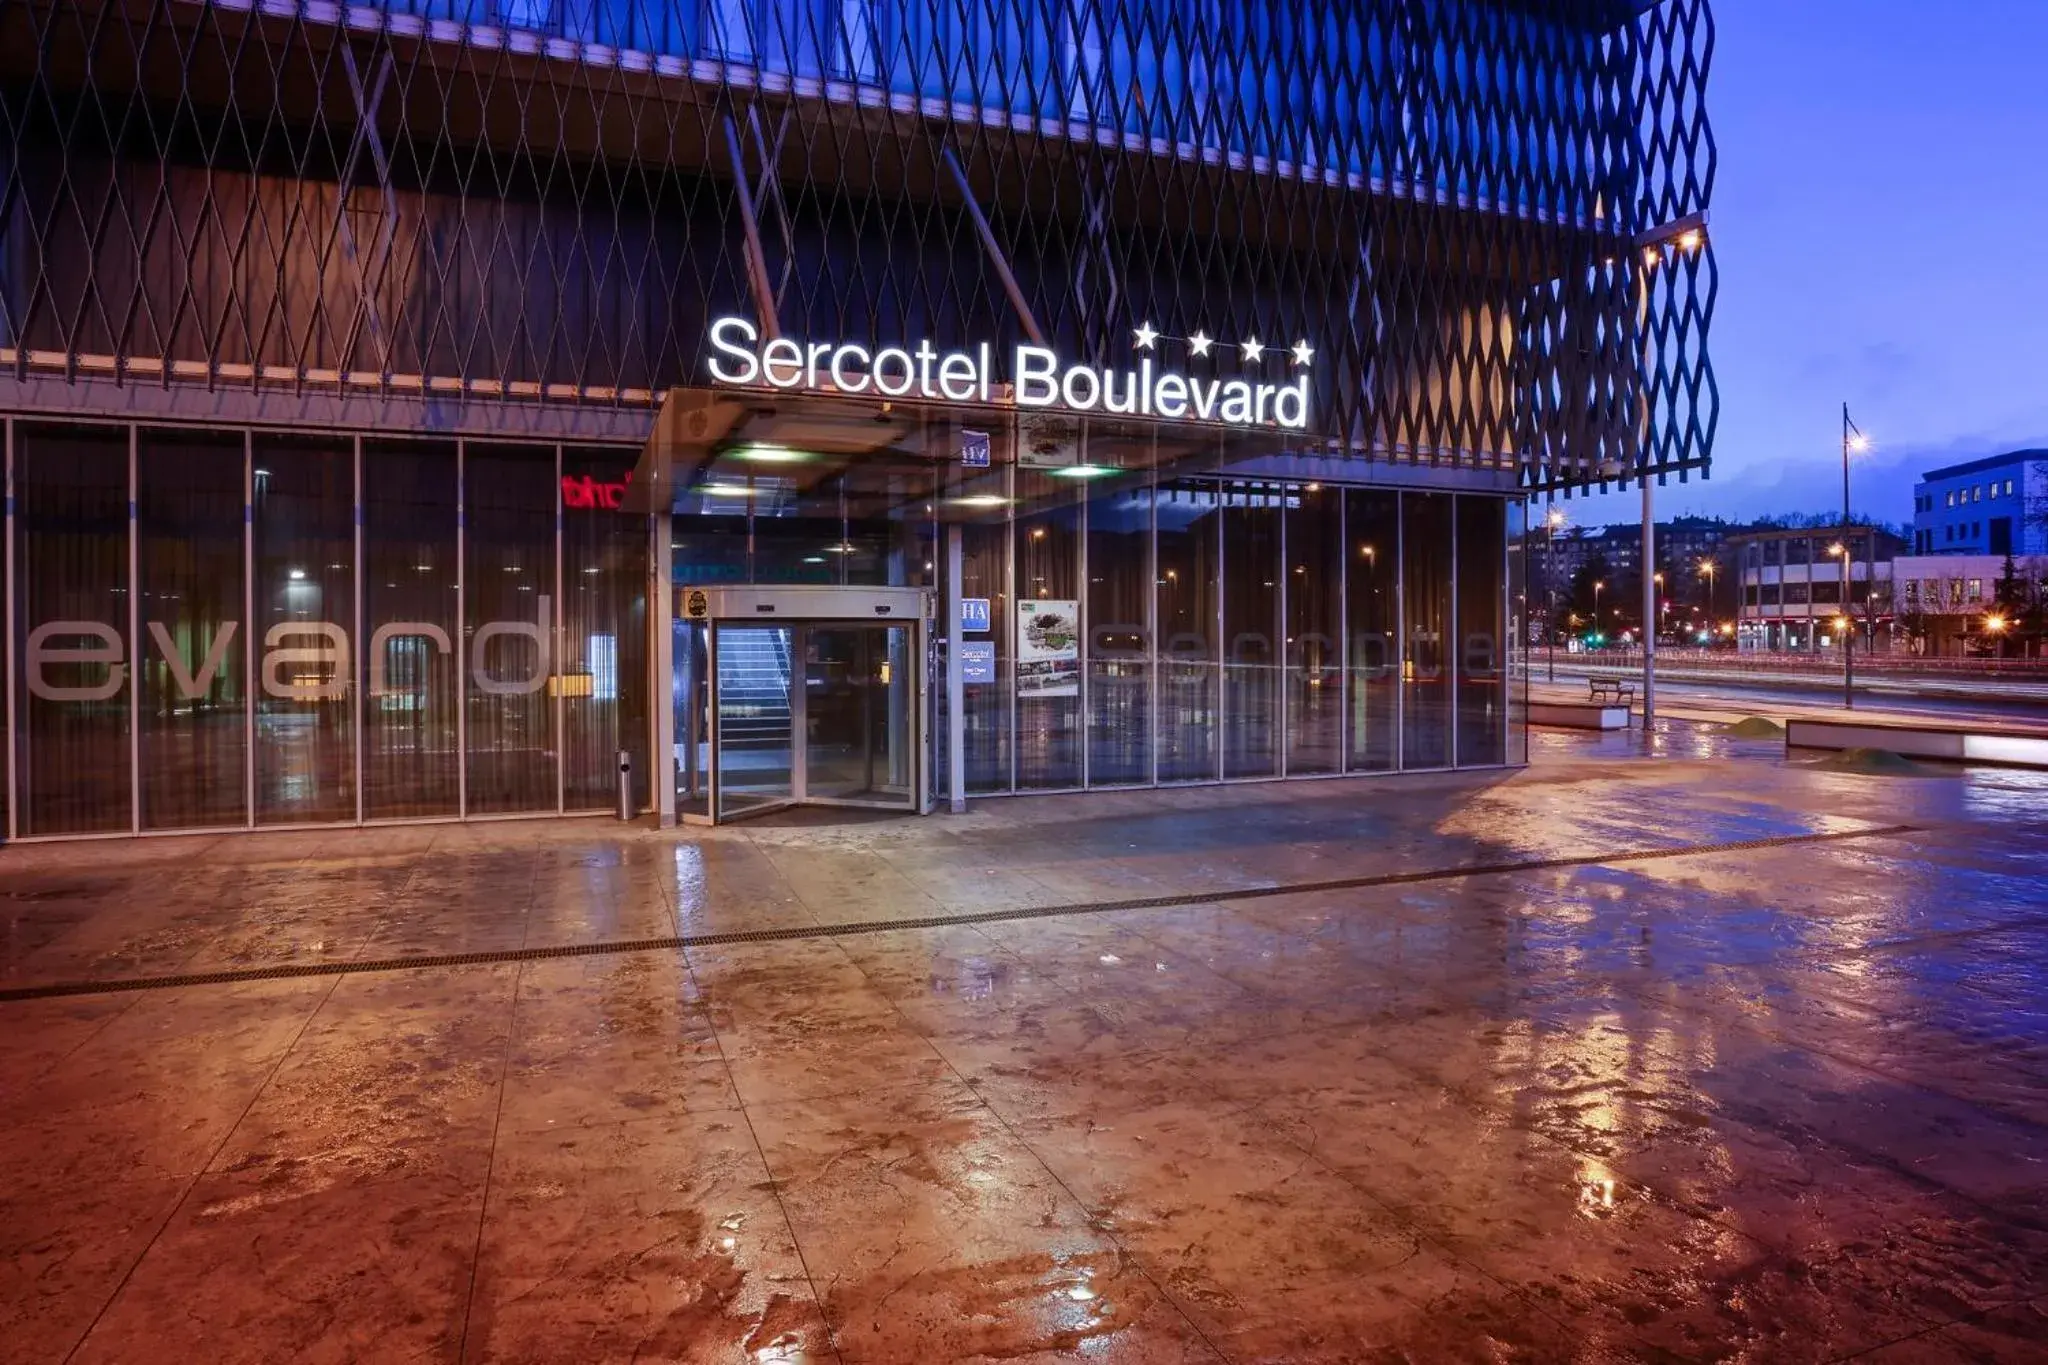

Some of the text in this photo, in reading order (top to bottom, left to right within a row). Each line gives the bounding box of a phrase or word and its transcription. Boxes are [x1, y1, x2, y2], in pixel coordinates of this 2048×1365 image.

[707, 317, 1309, 428] Sercotel Boulevard
[26, 595, 551, 700] evard
